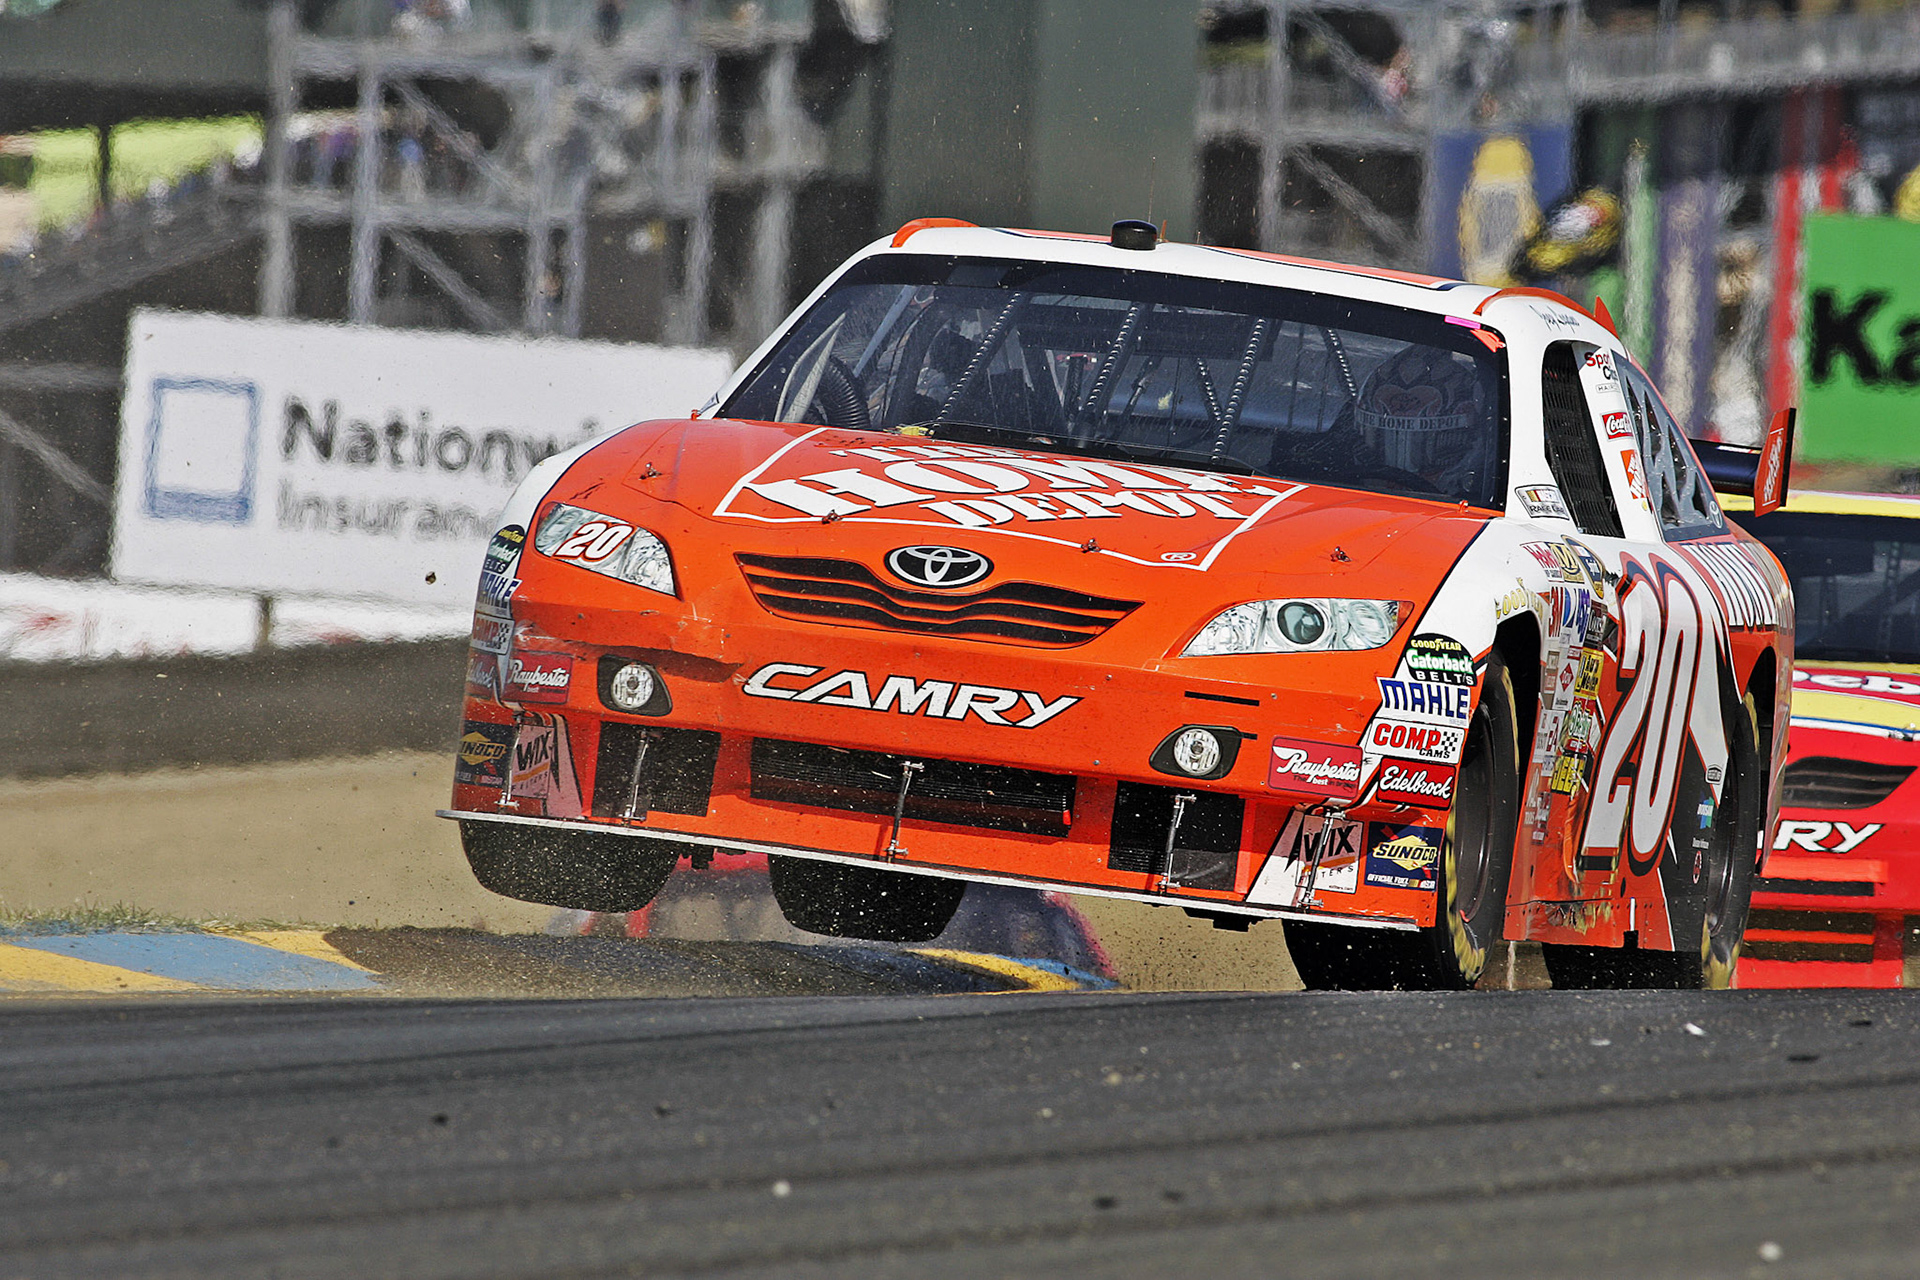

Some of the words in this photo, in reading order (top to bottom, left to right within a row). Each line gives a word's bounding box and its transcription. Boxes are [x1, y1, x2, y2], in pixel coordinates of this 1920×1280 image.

[1378, 417, 1415, 430] HOME
[1419, 416, 1460, 430] DEPOT
[829, 446, 1048, 463] THE
[743, 458, 1282, 517] HOME
[918, 490, 1250, 527] DEPOT
[555, 521, 635, 562] 20
[1405, 648, 1474, 675] Gatorback
[1410, 638, 1462, 651] GOODYEAR
[508, 659, 570, 691] Raybestos
[1415, 670, 1474, 686] BELTS
[742, 660, 1084, 730] CAMRY
[1381, 679, 1469, 720] MAHLE
[1373, 718, 1442, 751] COMP
[1582, 576, 1703, 862] 20
[517, 731, 550, 771] WIX
[1272, 746, 1361, 783] Raybestos
[1418, 747, 1451, 759] CAMS
[1380, 765, 1453, 799] Edelbrock
[1304, 824, 1358, 862] WIX
[1375, 843, 1437, 862] SUNOCO
